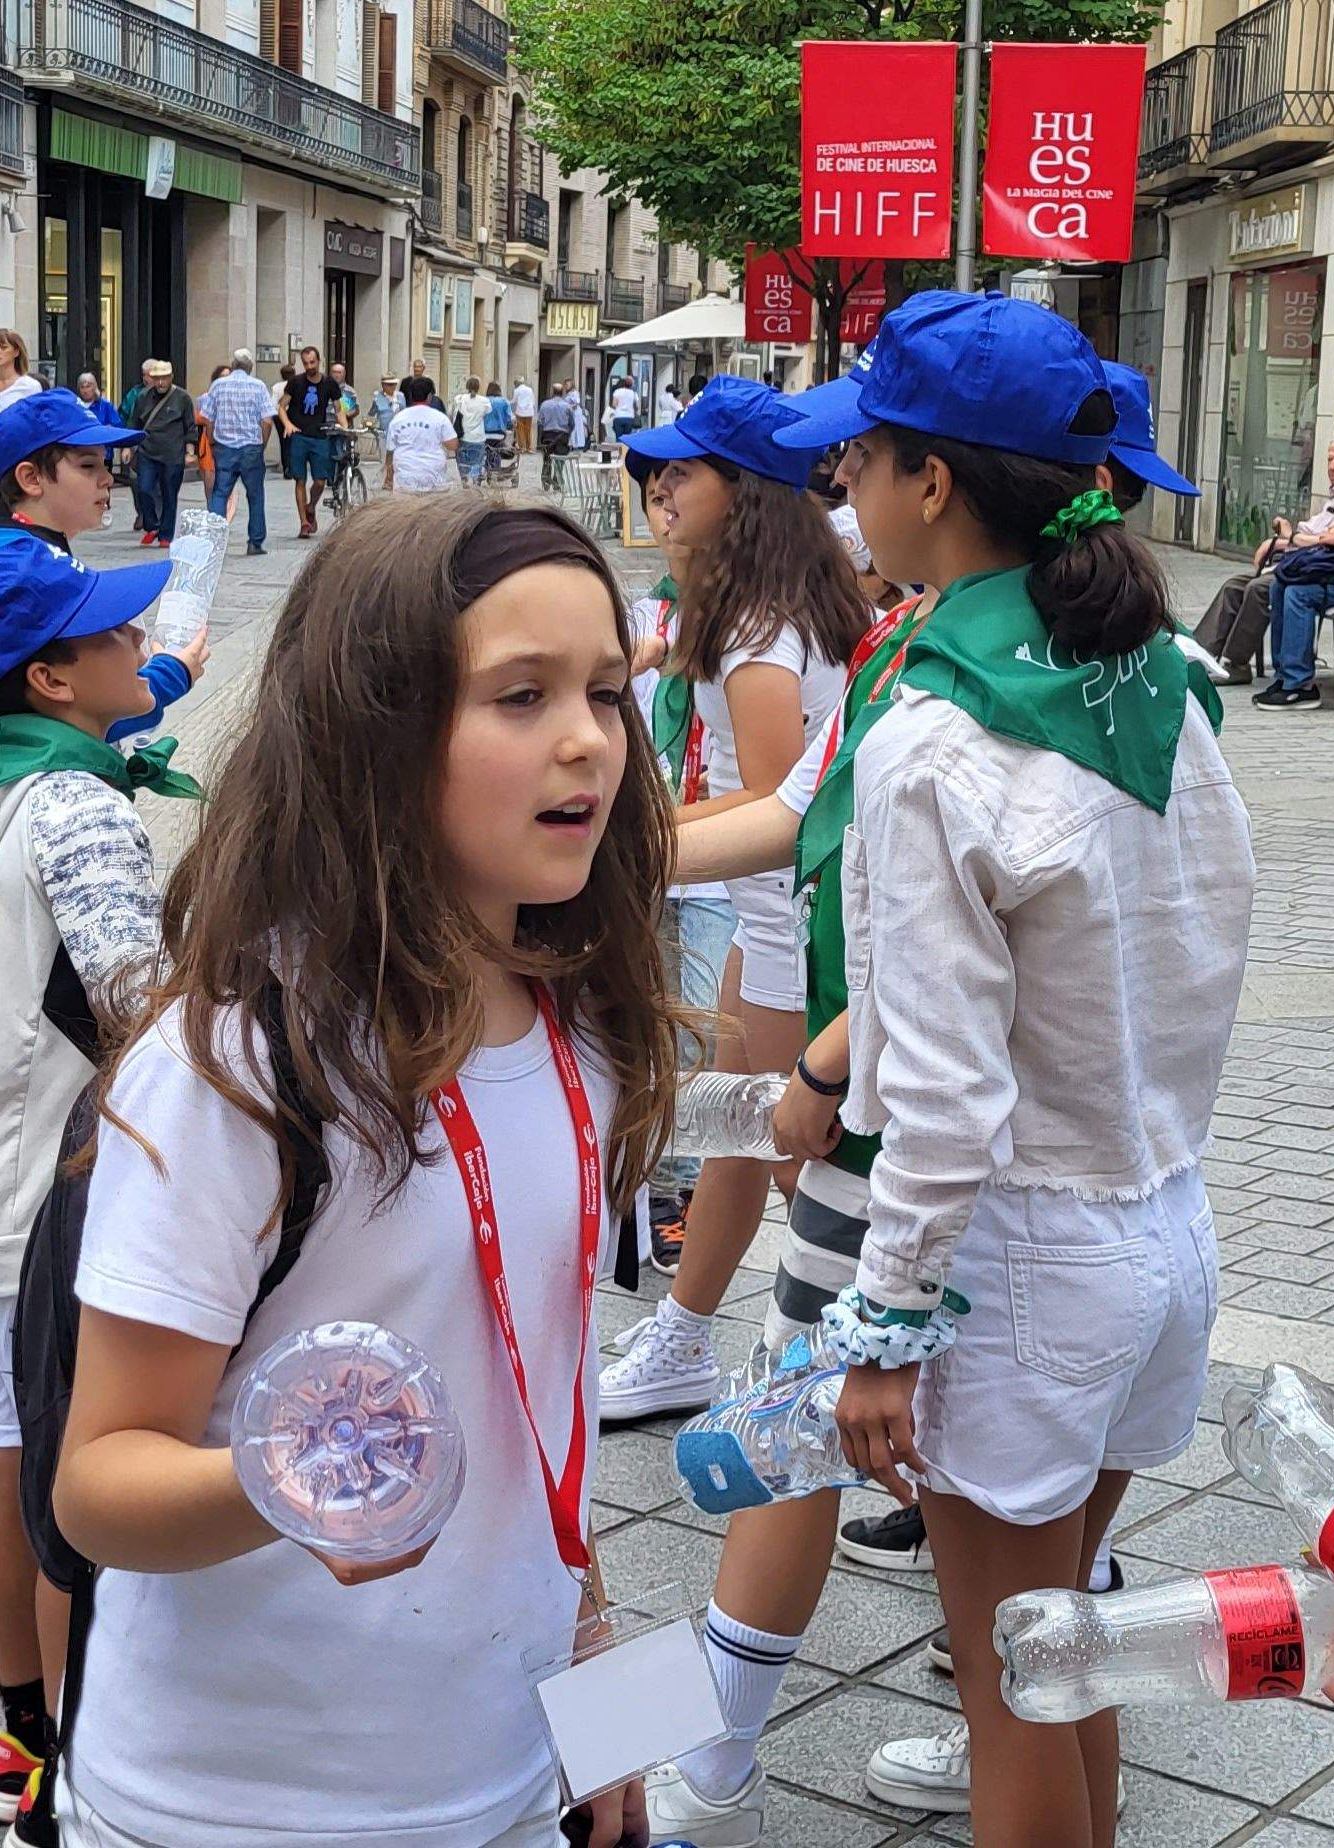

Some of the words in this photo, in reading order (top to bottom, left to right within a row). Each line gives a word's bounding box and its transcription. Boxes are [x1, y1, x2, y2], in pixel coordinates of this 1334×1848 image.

[1031, 112, 1094, 142] Hu
[816, 142, 860, 156] FESTIVAL
[861, 138, 937, 154] INTERNACIONAL
[816, 157, 834, 172] DE
[836, 157, 865, 173] CINE
[866, 158, 885, 173] DE
[886, 159, 937, 173] HUESCA
[1029, 145, 1091, 185] es
[813, 190, 937, 238] HIFF
[1027, 202, 1089, 239] ca
[764, 289, 793, 309] es
[763, 315, 793, 333] ca
